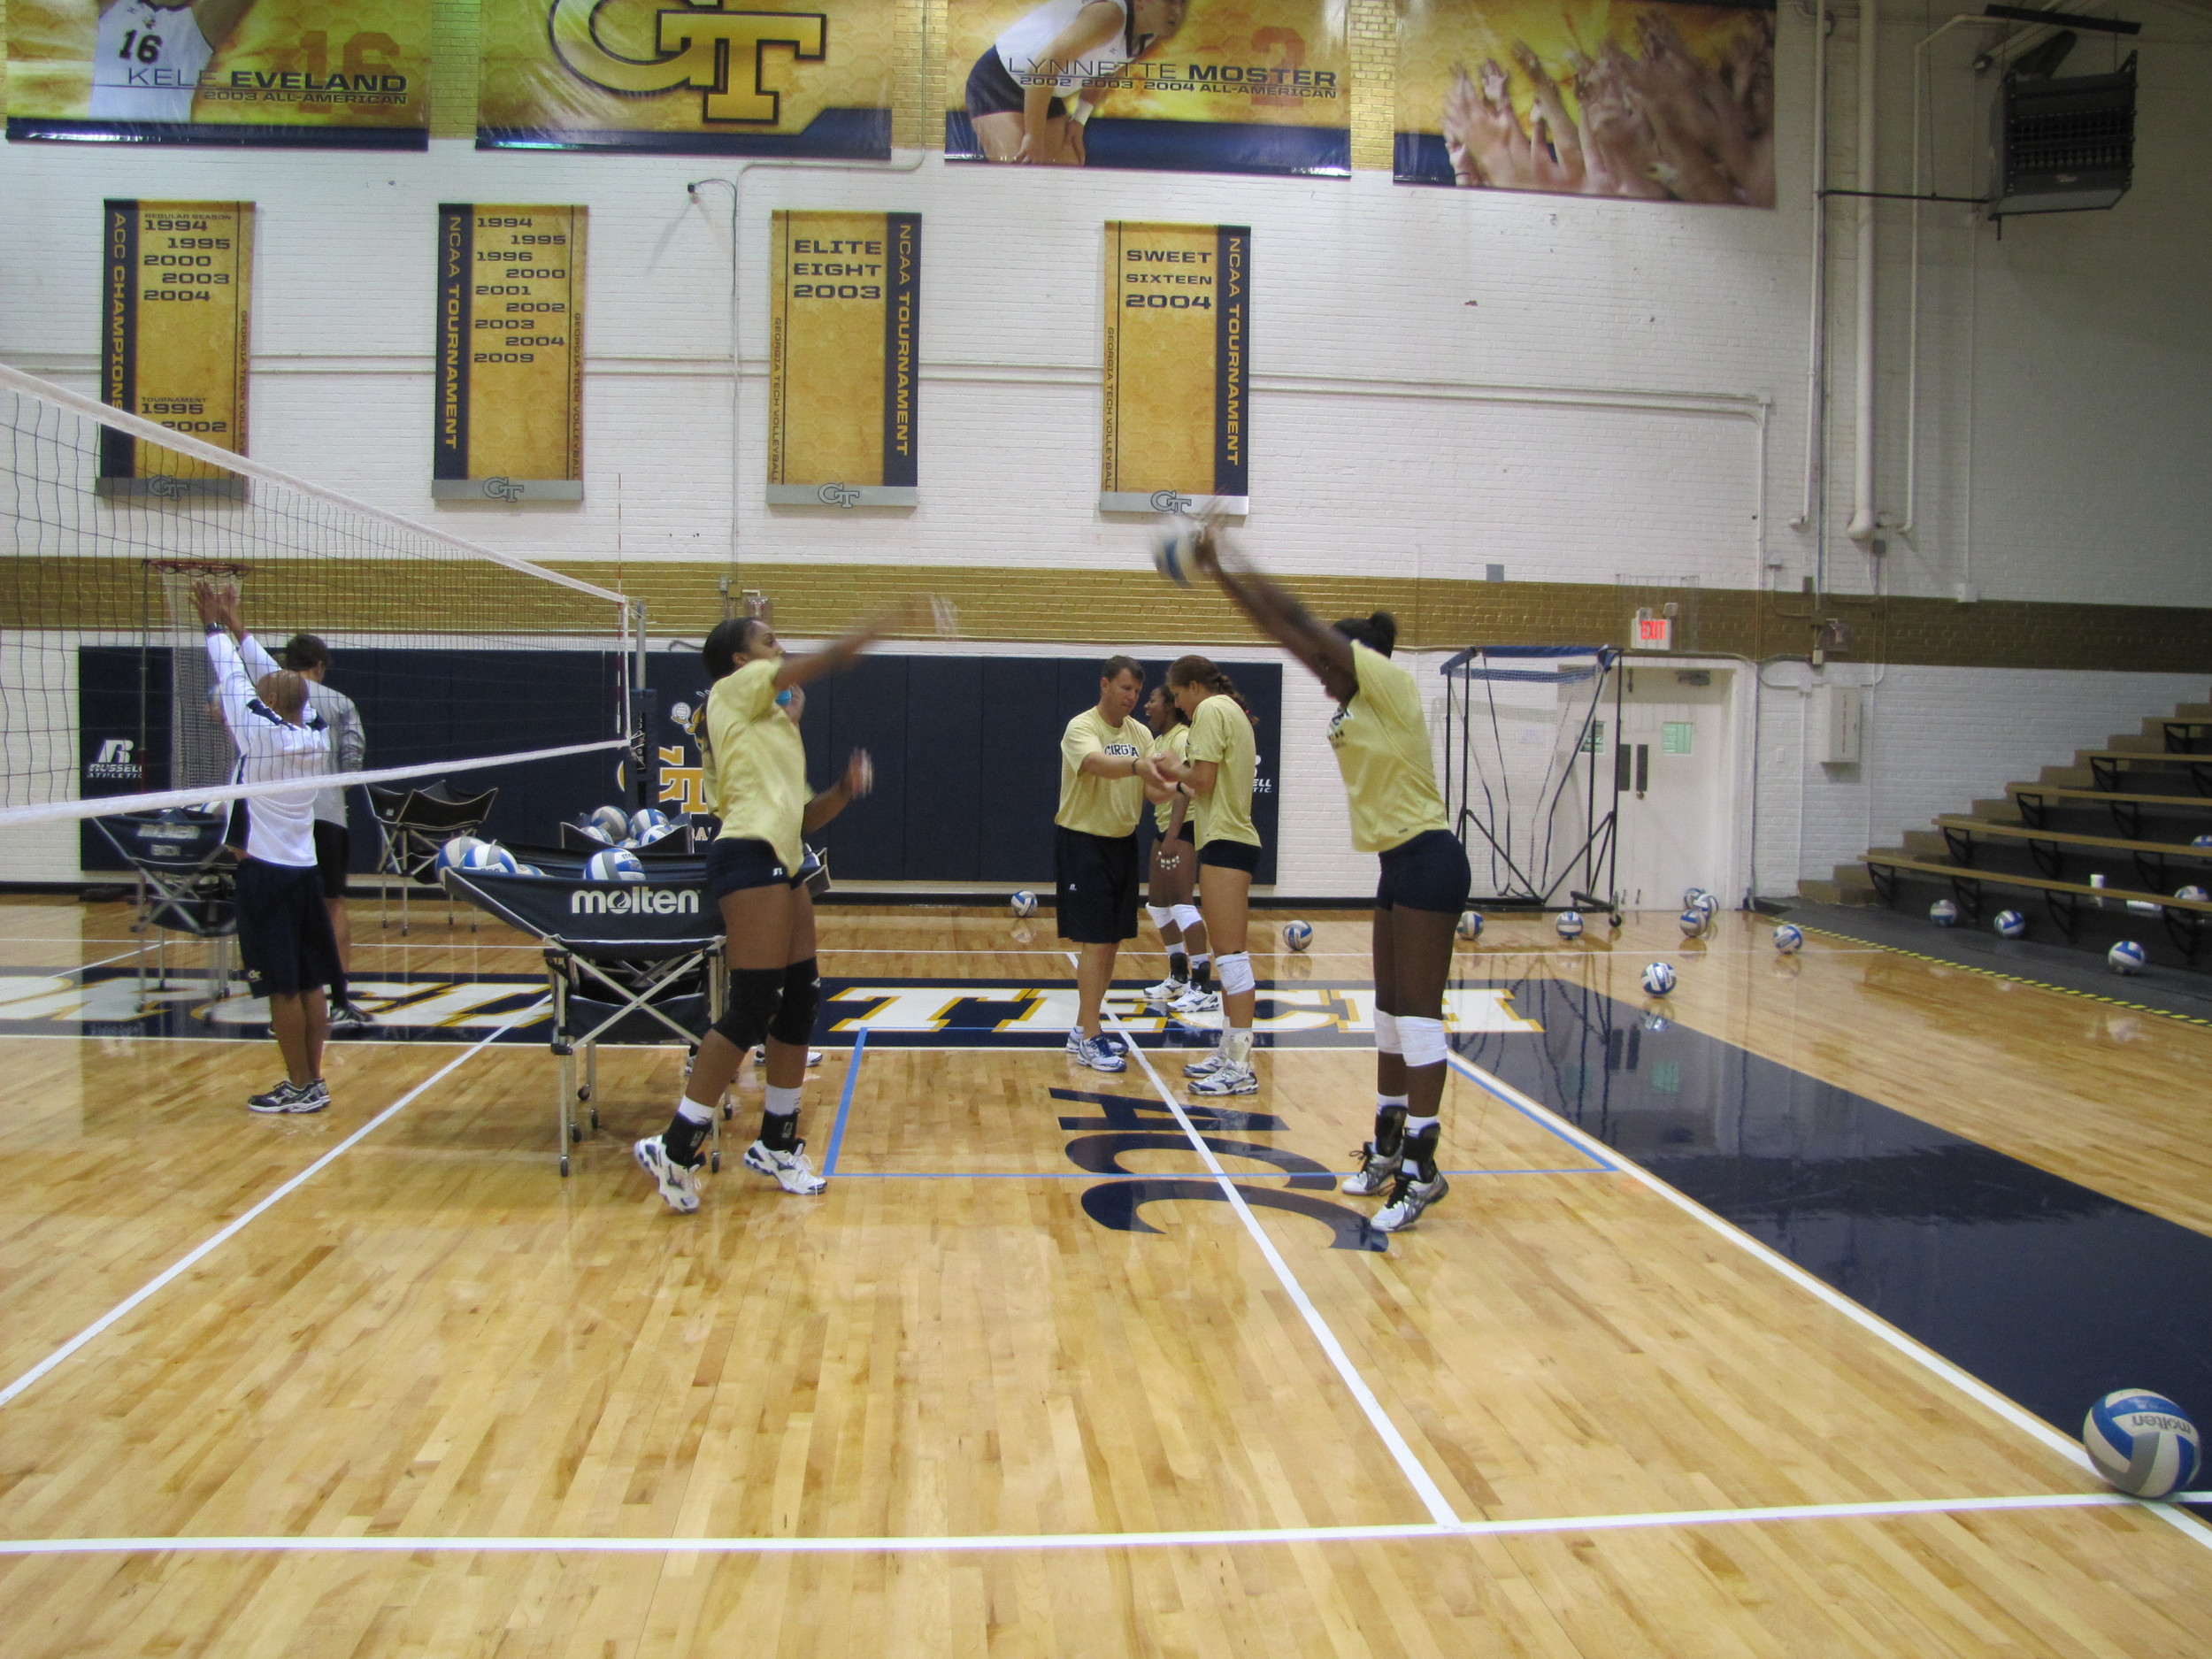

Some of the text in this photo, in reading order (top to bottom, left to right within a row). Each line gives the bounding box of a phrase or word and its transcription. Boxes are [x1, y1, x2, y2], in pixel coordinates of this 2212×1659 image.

[119, 29, 163, 64] 16
[1009, 58, 1337, 88] LYNNETTE MOSTER
[231, 71, 407, 93] EVELAND
[1020, 77, 1337, 99] 2002 2003 2004 ALL-AMERICAN
[204, 91, 407, 105] 2003 ALL-AMERICAN
[144, 219, 208, 231] 1994
[477, 218, 533, 228] 1994
[167, 237, 230, 250] 1995
[511, 235, 566, 245] 1995
[794, 240, 882, 255] ELITE
[143, 255, 211, 266] 2000
[476, 252, 533, 262] 1996
[1126, 250, 1212, 264] SWEET
[506, 269, 566, 280] 2000
[794, 264, 882, 276] EIGHT
[162, 273, 230, 284] 2003
[1126, 273, 1212, 285] SIXTEEN
[143, 289, 211, 302] 2004
[475, 286, 531, 296] 2001
[794, 285, 881, 299] 2003
[506, 303, 565, 313] 2002
[1125, 295, 1211, 310] 2004
[111, 212, 127, 411] ACC CHAMPIONS
[474, 319, 534, 330] 2003
[445, 217, 461, 449] NCAA TOURNAMENT
[505, 336, 565, 347] 2004
[895, 225, 912, 456] NCAA TOURNAMENT
[473, 353, 534, 364] 2009
[1226, 238, 1240, 465] NCAA TOURNAMENT
[142, 403, 204, 415] 1995
[160, 421, 227, 433] 2002
[147, 474, 190, 501] GT
[482, 477, 525, 503] GT
[818, 483, 860, 508] GT
[1151, 490, 1192, 516] GT
[1640, 620, 1667, 640] EXIT
[572, 886, 700, 914] molten
[2131, 1415, 2192, 1435] molten
